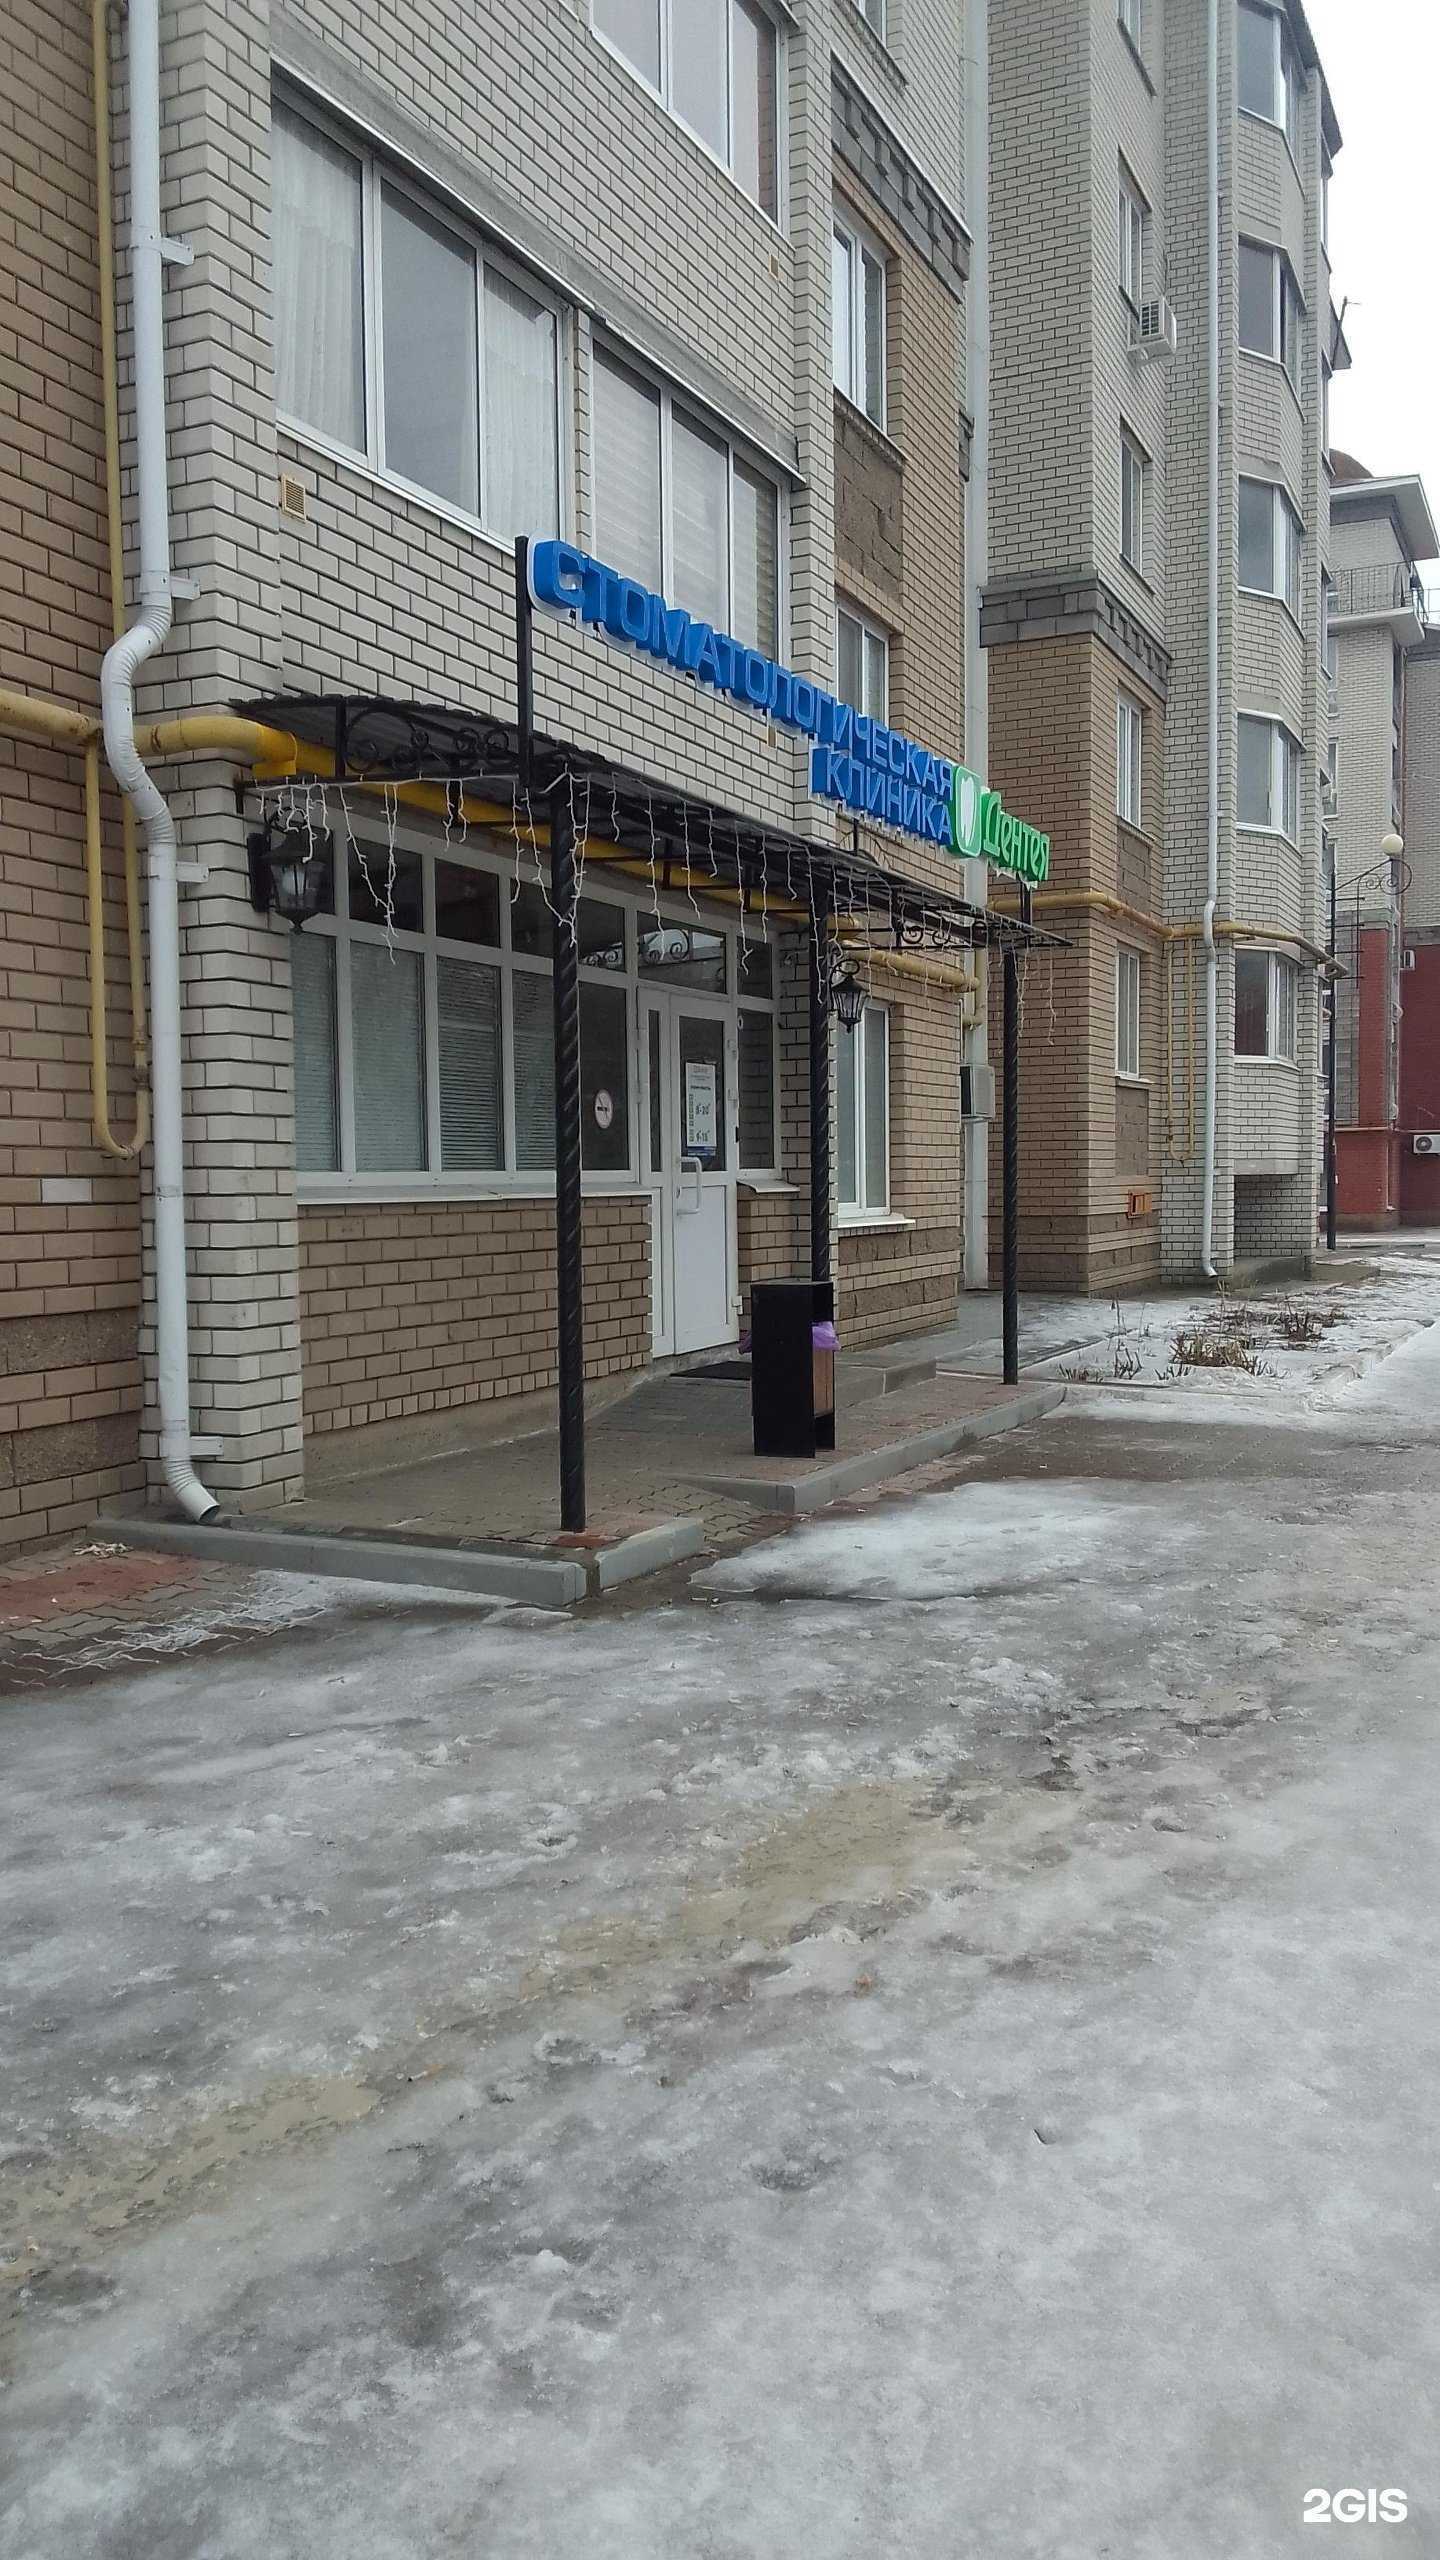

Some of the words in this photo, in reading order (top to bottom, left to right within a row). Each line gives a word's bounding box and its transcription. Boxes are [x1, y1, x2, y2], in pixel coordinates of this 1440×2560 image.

[534, 540, 952, 796] СТОМАТОЛОГИЧЕСКАЯ
[812, 746, 953, 846] КЛИНИКА
[981, 791, 1050, 881] Дентея
